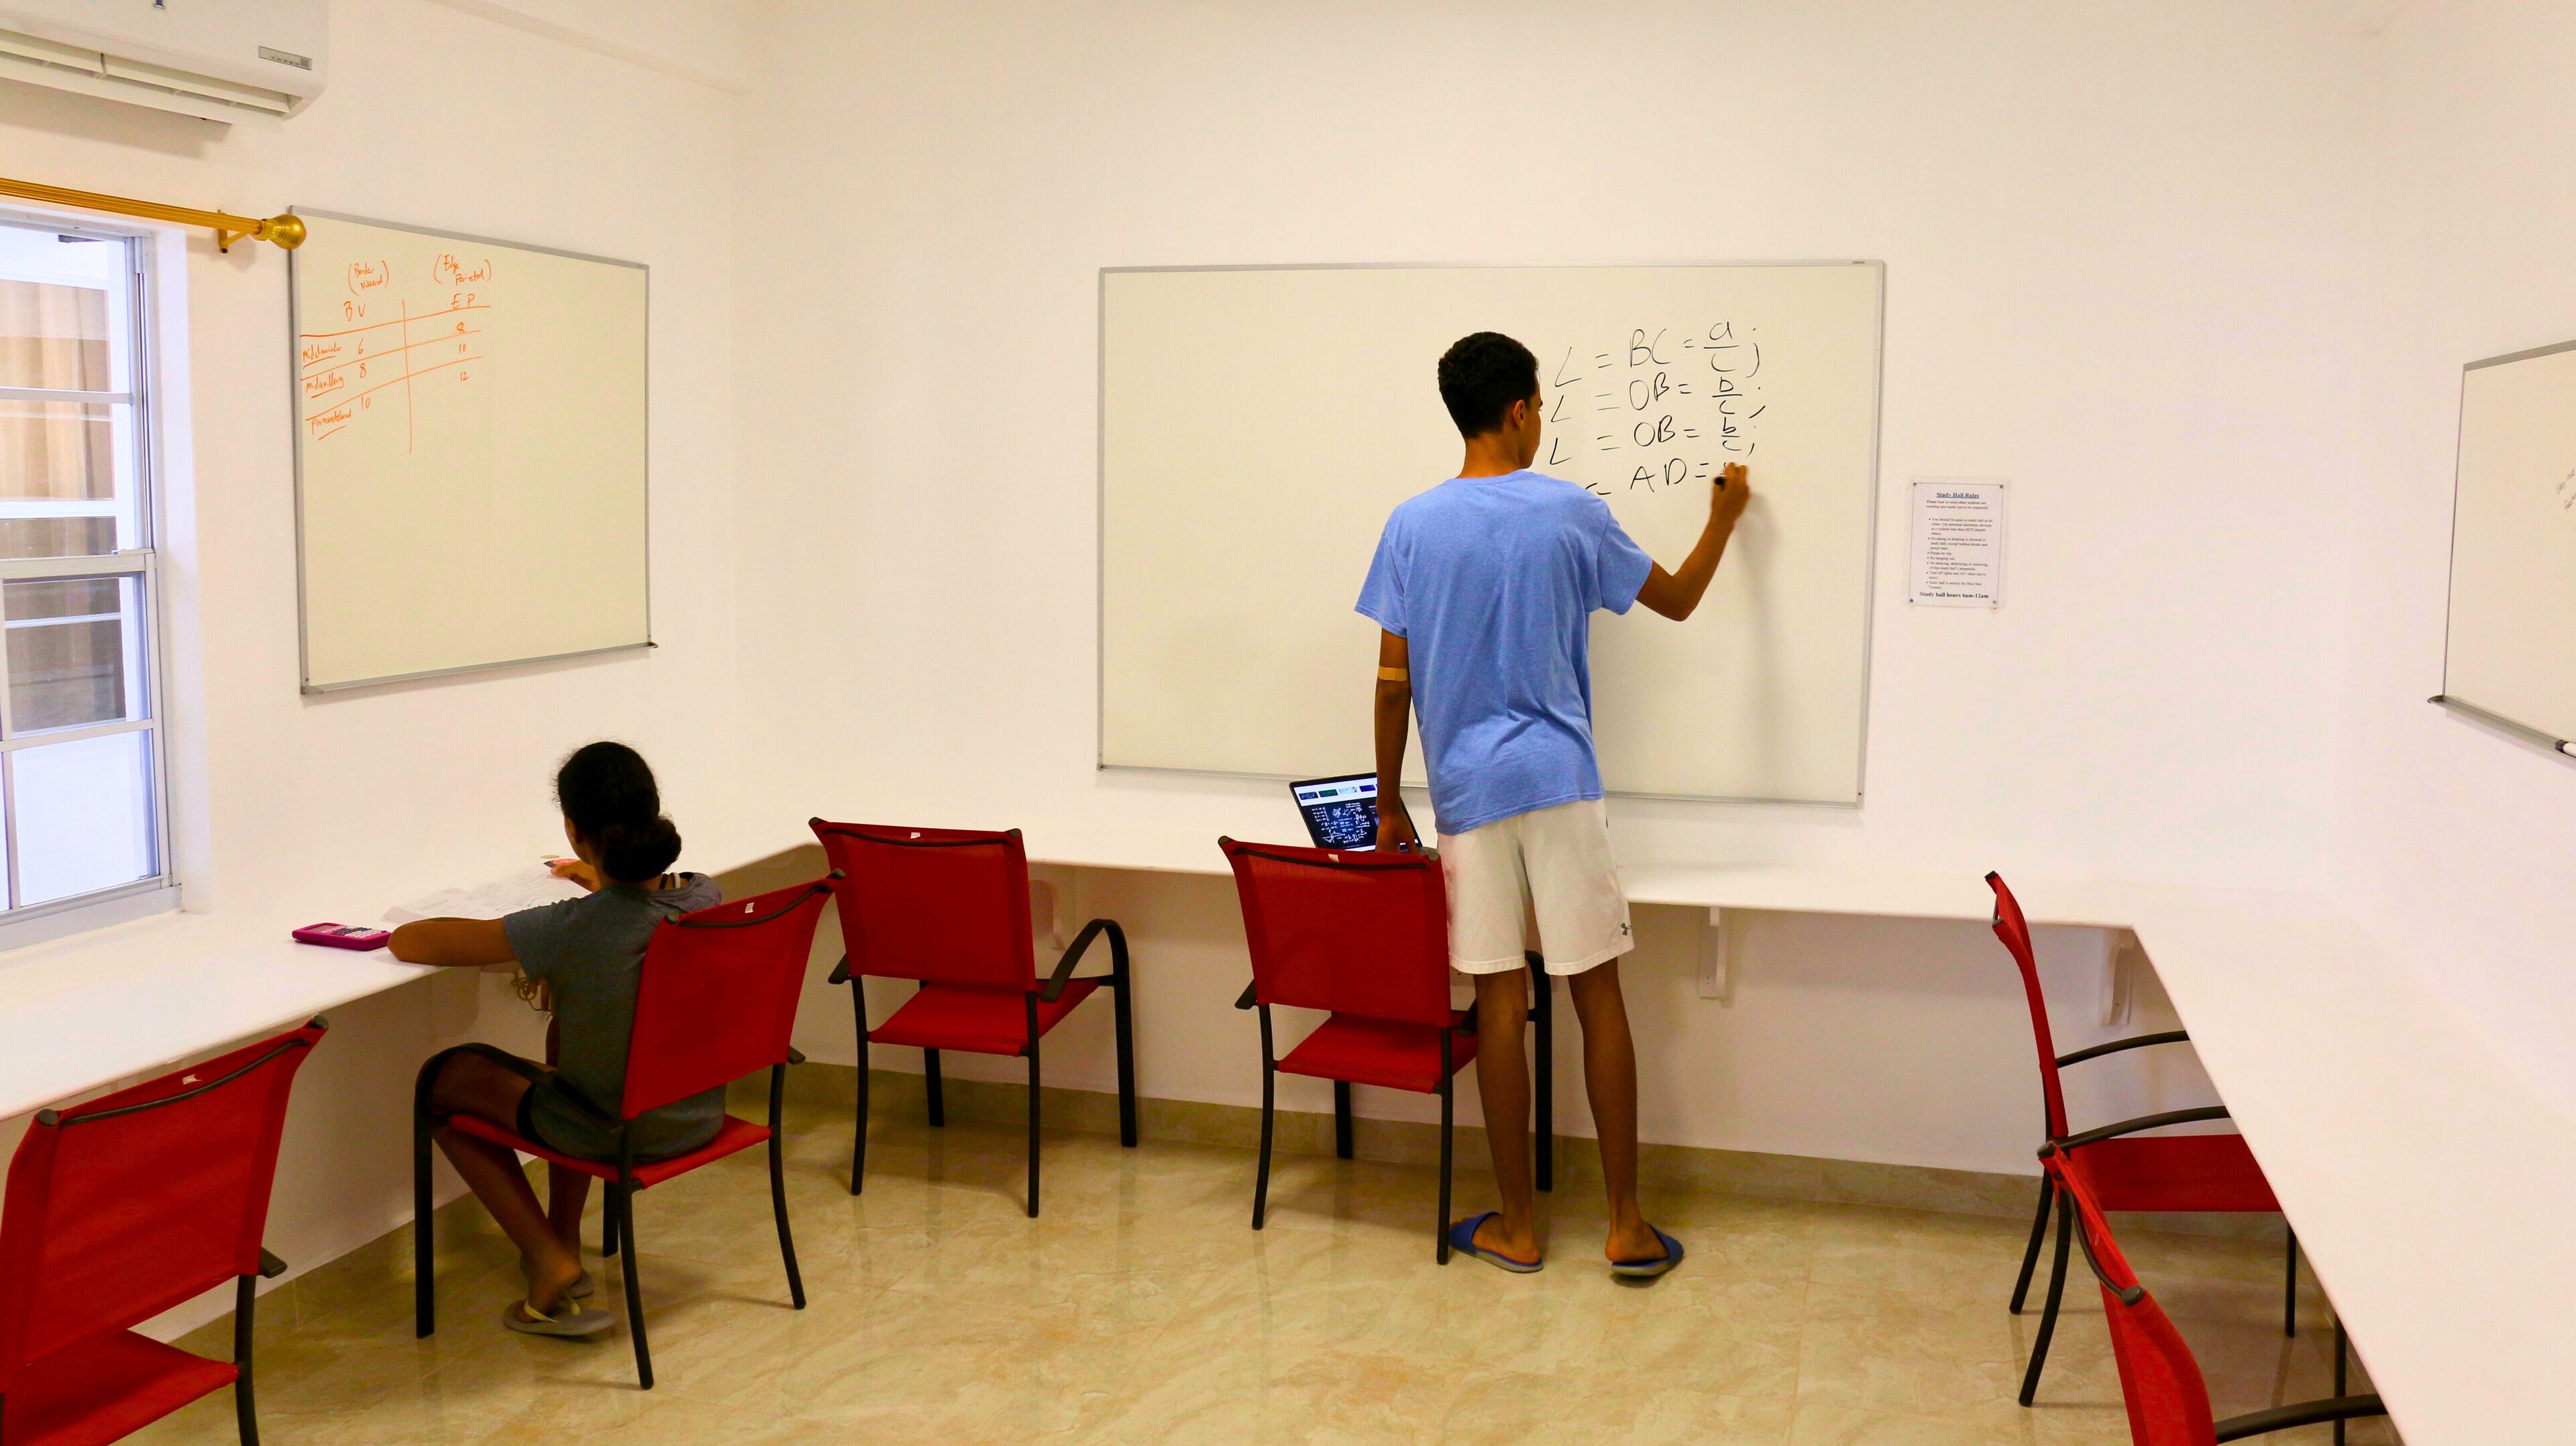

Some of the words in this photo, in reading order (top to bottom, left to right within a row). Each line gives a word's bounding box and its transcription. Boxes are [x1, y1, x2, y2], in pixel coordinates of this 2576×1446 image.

[451, 293, 462, 309] E
[467, 293, 476, 307] P
[456, 322, 466, 334] 8
[357, 338, 364, 354] 6
[1630, 329, 1671, 368] BC
[360, 362, 367, 378] 8
[460, 372, 470, 381] 12
[1629, 372, 1670, 411] OB
[361, 396, 370, 411] 10
[1633, 415, 1676, 447] OB
